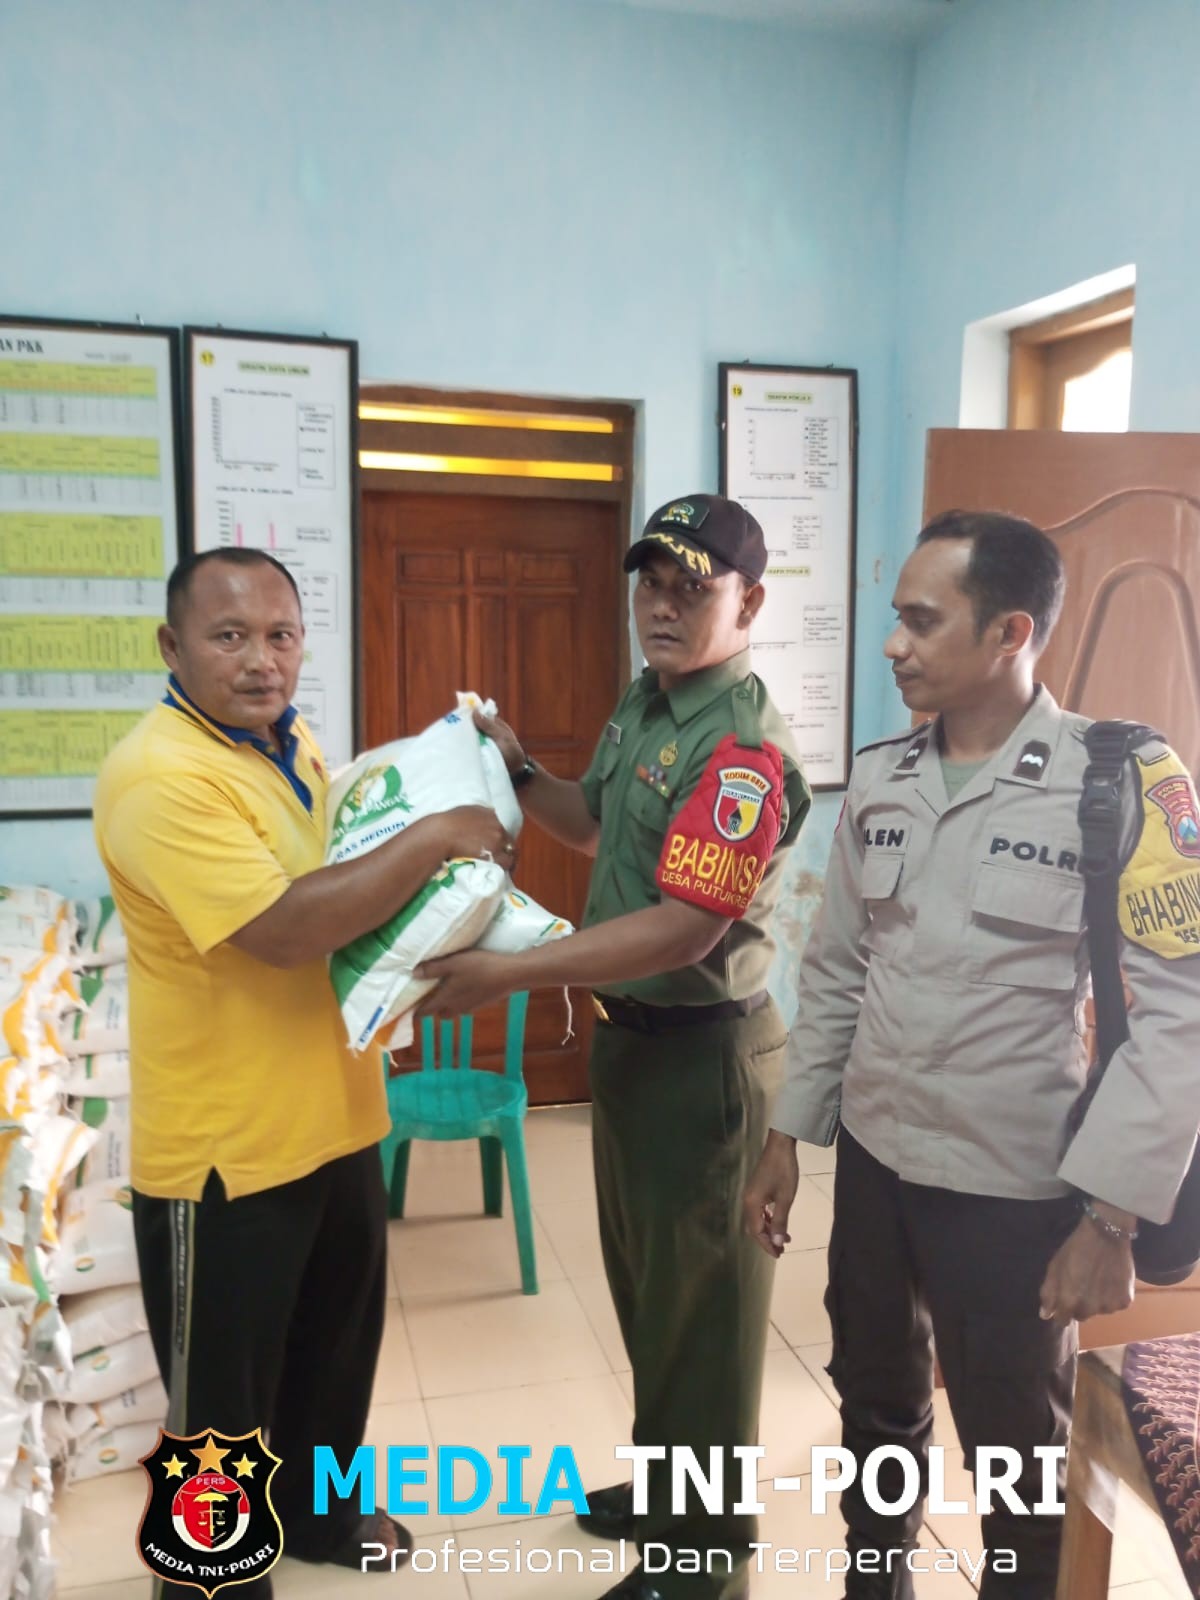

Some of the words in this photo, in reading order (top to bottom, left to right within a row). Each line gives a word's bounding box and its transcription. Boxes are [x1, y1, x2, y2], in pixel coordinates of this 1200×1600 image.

[336, 842, 358, 860] RAS
[360, 821, 406, 845] MEDIUM
[863, 828, 905, 847] LEN
[665, 834, 767, 896] BABINSA
[661, 870, 690, 889] DESA
[693, 878, 753, 909] PUTUKRE
